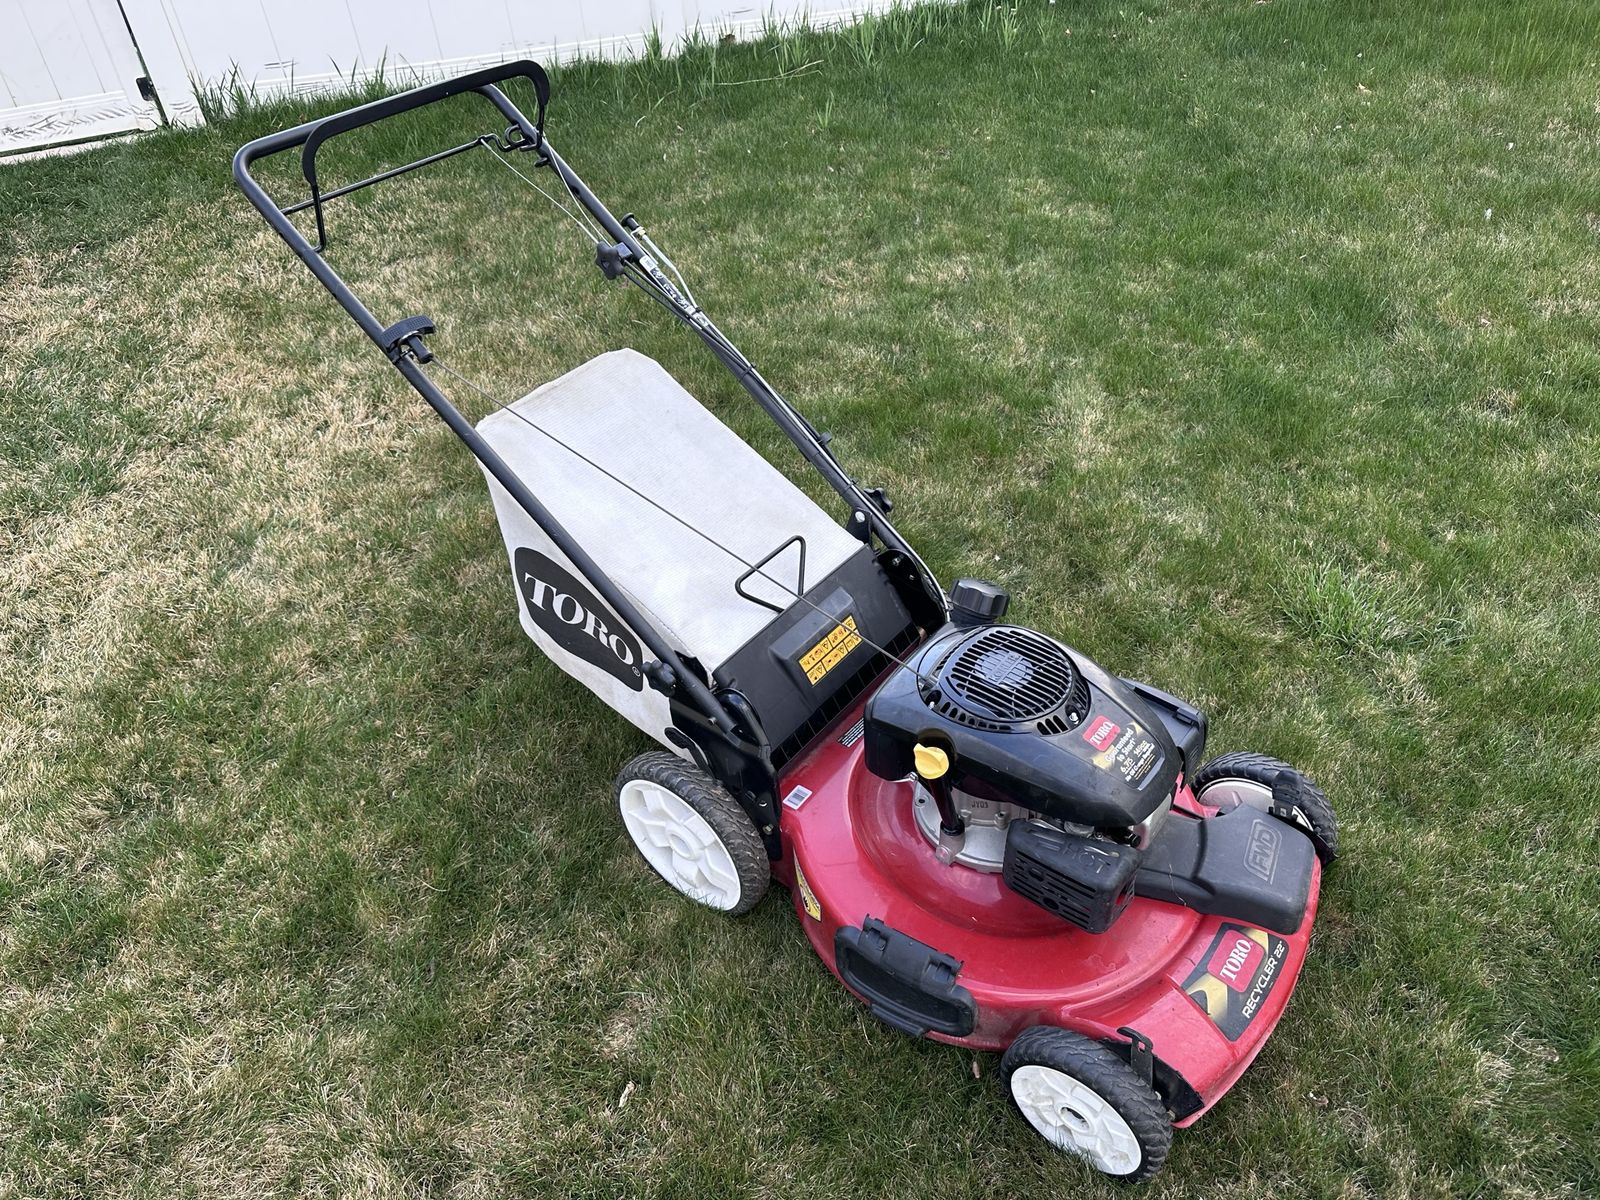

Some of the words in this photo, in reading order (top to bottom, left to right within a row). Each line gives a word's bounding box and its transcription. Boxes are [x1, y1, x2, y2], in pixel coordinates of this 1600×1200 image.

[525, 572, 634, 665] TORO
[1089, 721, 1114, 745] TORO
[1104, 727, 1134, 762] Guaranteed
[1116, 754, 1125, 762] to
[1120, 757, 1133, 773] 6.75
[1252, 829, 1276, 872] FWD
[1220, 939, 1252, 981] TORO
[1241, 957, 1279, 1019] RECYCLER
